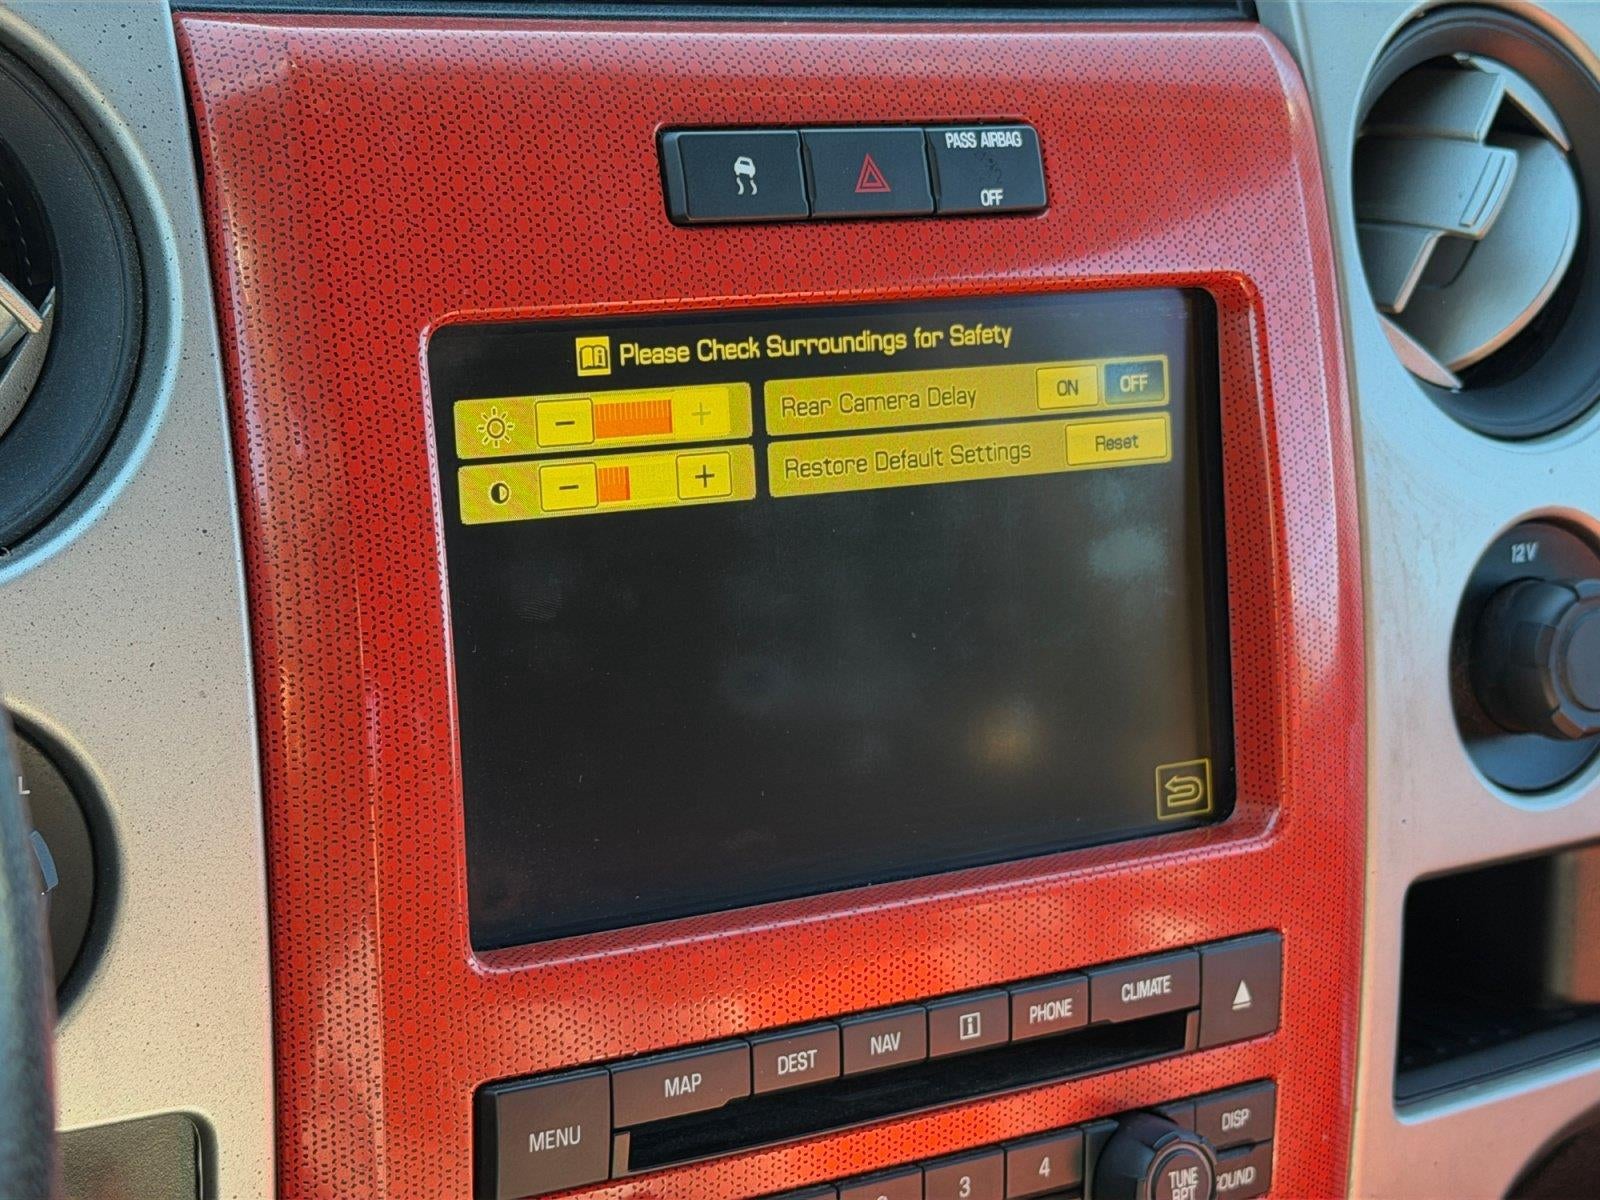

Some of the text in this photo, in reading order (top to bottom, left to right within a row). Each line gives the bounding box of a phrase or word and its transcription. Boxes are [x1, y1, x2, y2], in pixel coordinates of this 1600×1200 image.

[945, 131, 1022, 149] PASS AIRBAG
[980, 188, 1003, 206] OFF
[620, 323, 1012, 366] Please Check Surroundings for Safety
[1056, 378, 1079, 397] ON
[1119, 374, 1148, 394] OFF
[781, 386, 976, 418] Rear Camera Delay
[1095, 434, 1139, 452] Reset
[785, 440, 1032, 480] Restore Default Settings
[1511, 541, 1538, 563] 12V
[1121, 974, 1171, 1002] CLIMATE
[1029, 998, 1073, 1025] PHONE
[870, 1031, 900, 1056] NAV
[777, 1049, 818, 1075] DEST
[664, 1073, 702, 1098] MAP
[1222, 1108, 1250, 1131] DISP
[528, 1125, 582, 1153] MENU
[1038, 1157, 1051, 1178] 4
[1168, 1166, 1199, 1188] TUNE
[959, 1176, 971, 1198] 3
